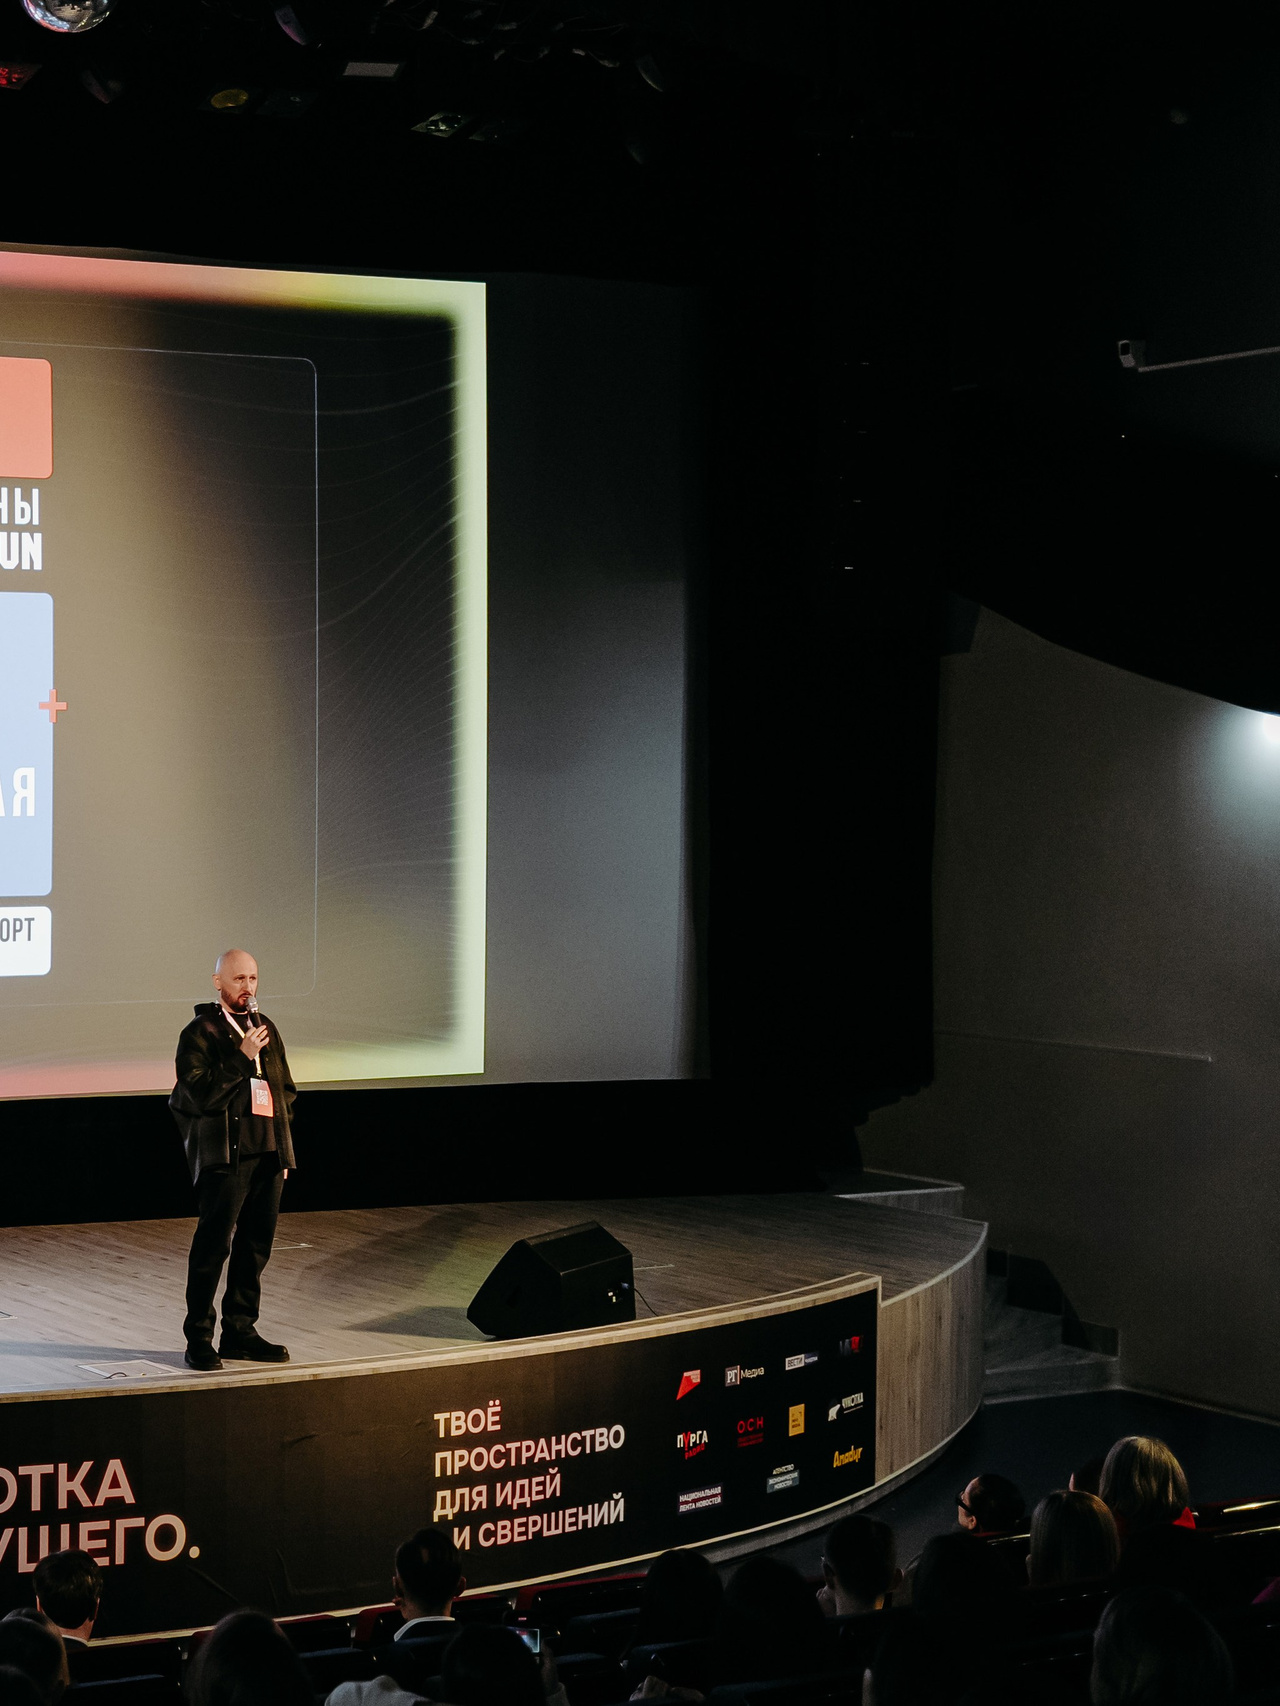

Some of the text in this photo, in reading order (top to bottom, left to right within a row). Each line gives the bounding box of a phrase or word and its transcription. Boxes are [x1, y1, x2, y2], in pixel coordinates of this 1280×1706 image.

[740, 1367, 765, 1379] Медиа
[434, 1400, 501, 1438] ТВОЁ
[737, 1416, 764, 1434] ОСН
[435, 1424, 625, 1477] ПРОСТРАНСТВО
[677, 1430, 708, 1451] ПУРГА
[433, 1467, 561, 1522] ДЛЯ ИДЕЙ
[679, 1486, 722, 1502] НАЦИОНАЛЬНАЯ
[453, 1492, 625, 1550] И СВЕРШЕНИЙ
